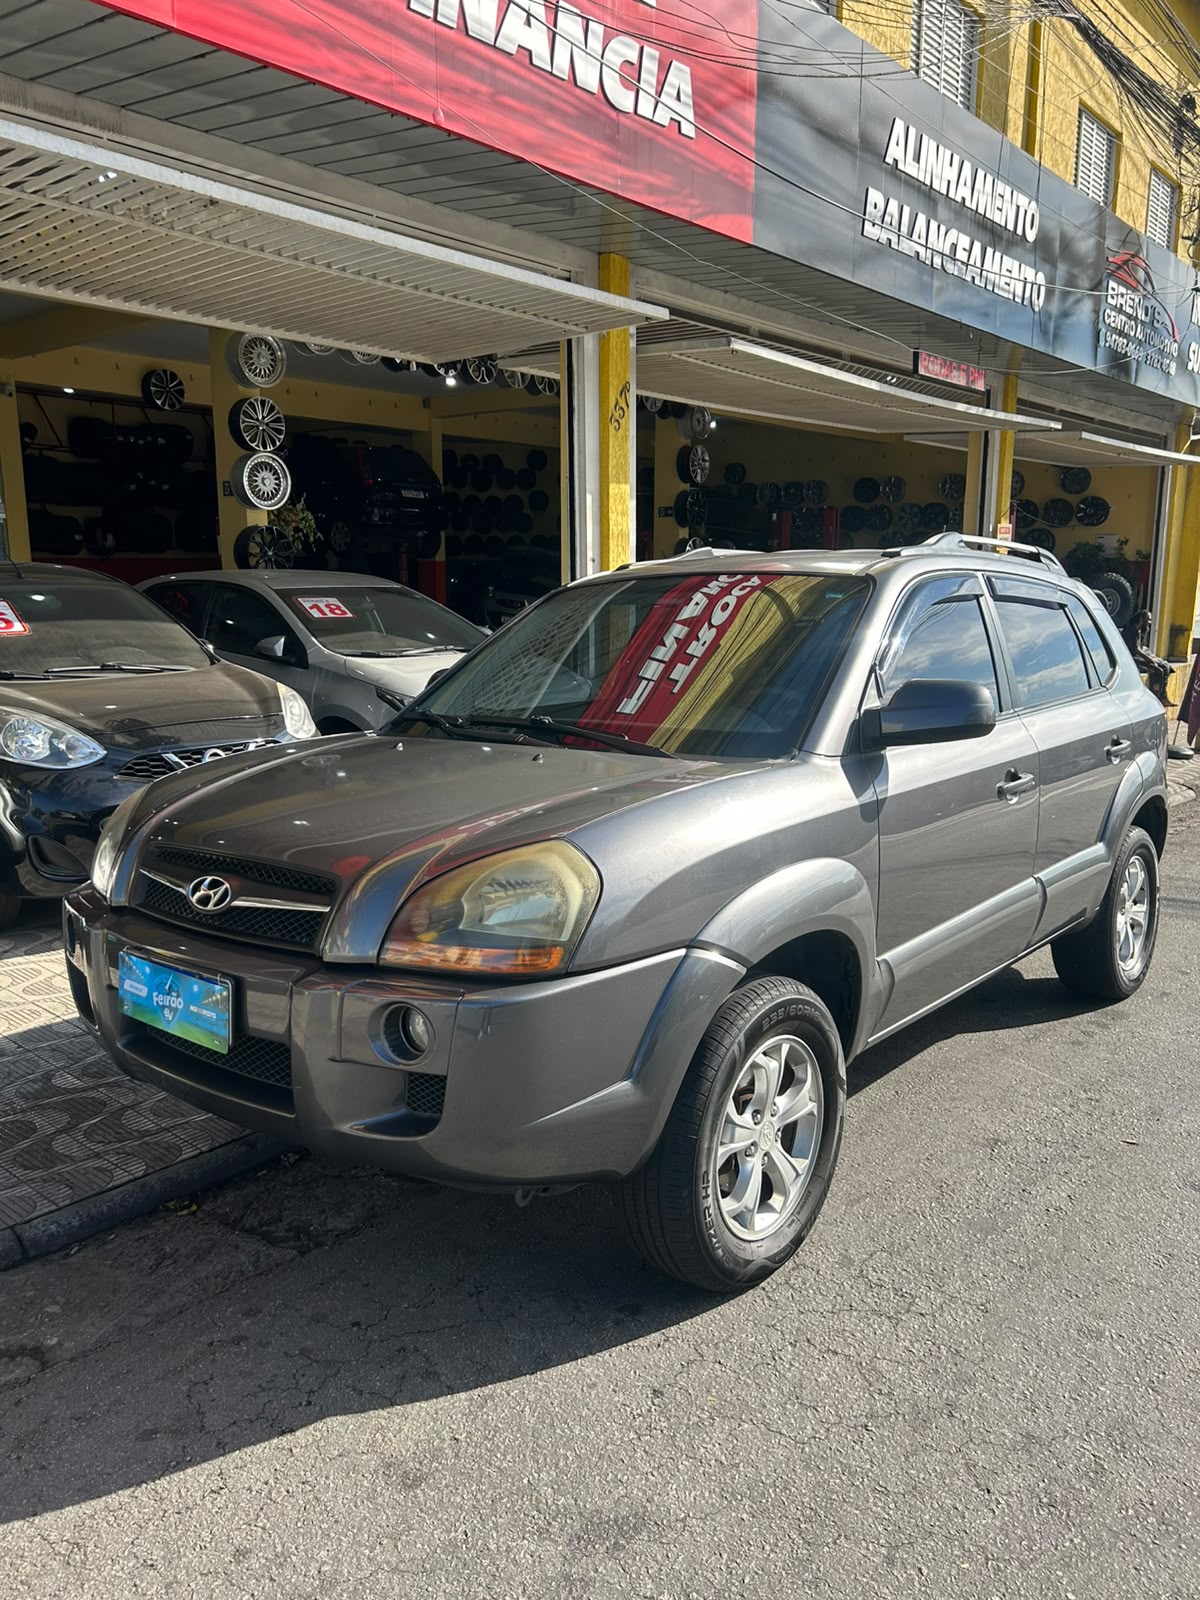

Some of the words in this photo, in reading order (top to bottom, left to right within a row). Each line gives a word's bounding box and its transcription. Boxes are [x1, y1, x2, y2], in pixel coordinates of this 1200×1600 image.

[408, 0, 696, 139] ANCIA
[883, 117, 1040, 243] ALINHAMENTO
[861, 186, 1047, 313] BALANCEAMENTO
[1103, 308, 1136, 336] CENTRO
[308, 602, 349, 617] 18
[152, 991, 185, 1009] Feirão
[701, 1170, 711, 1200] HP
